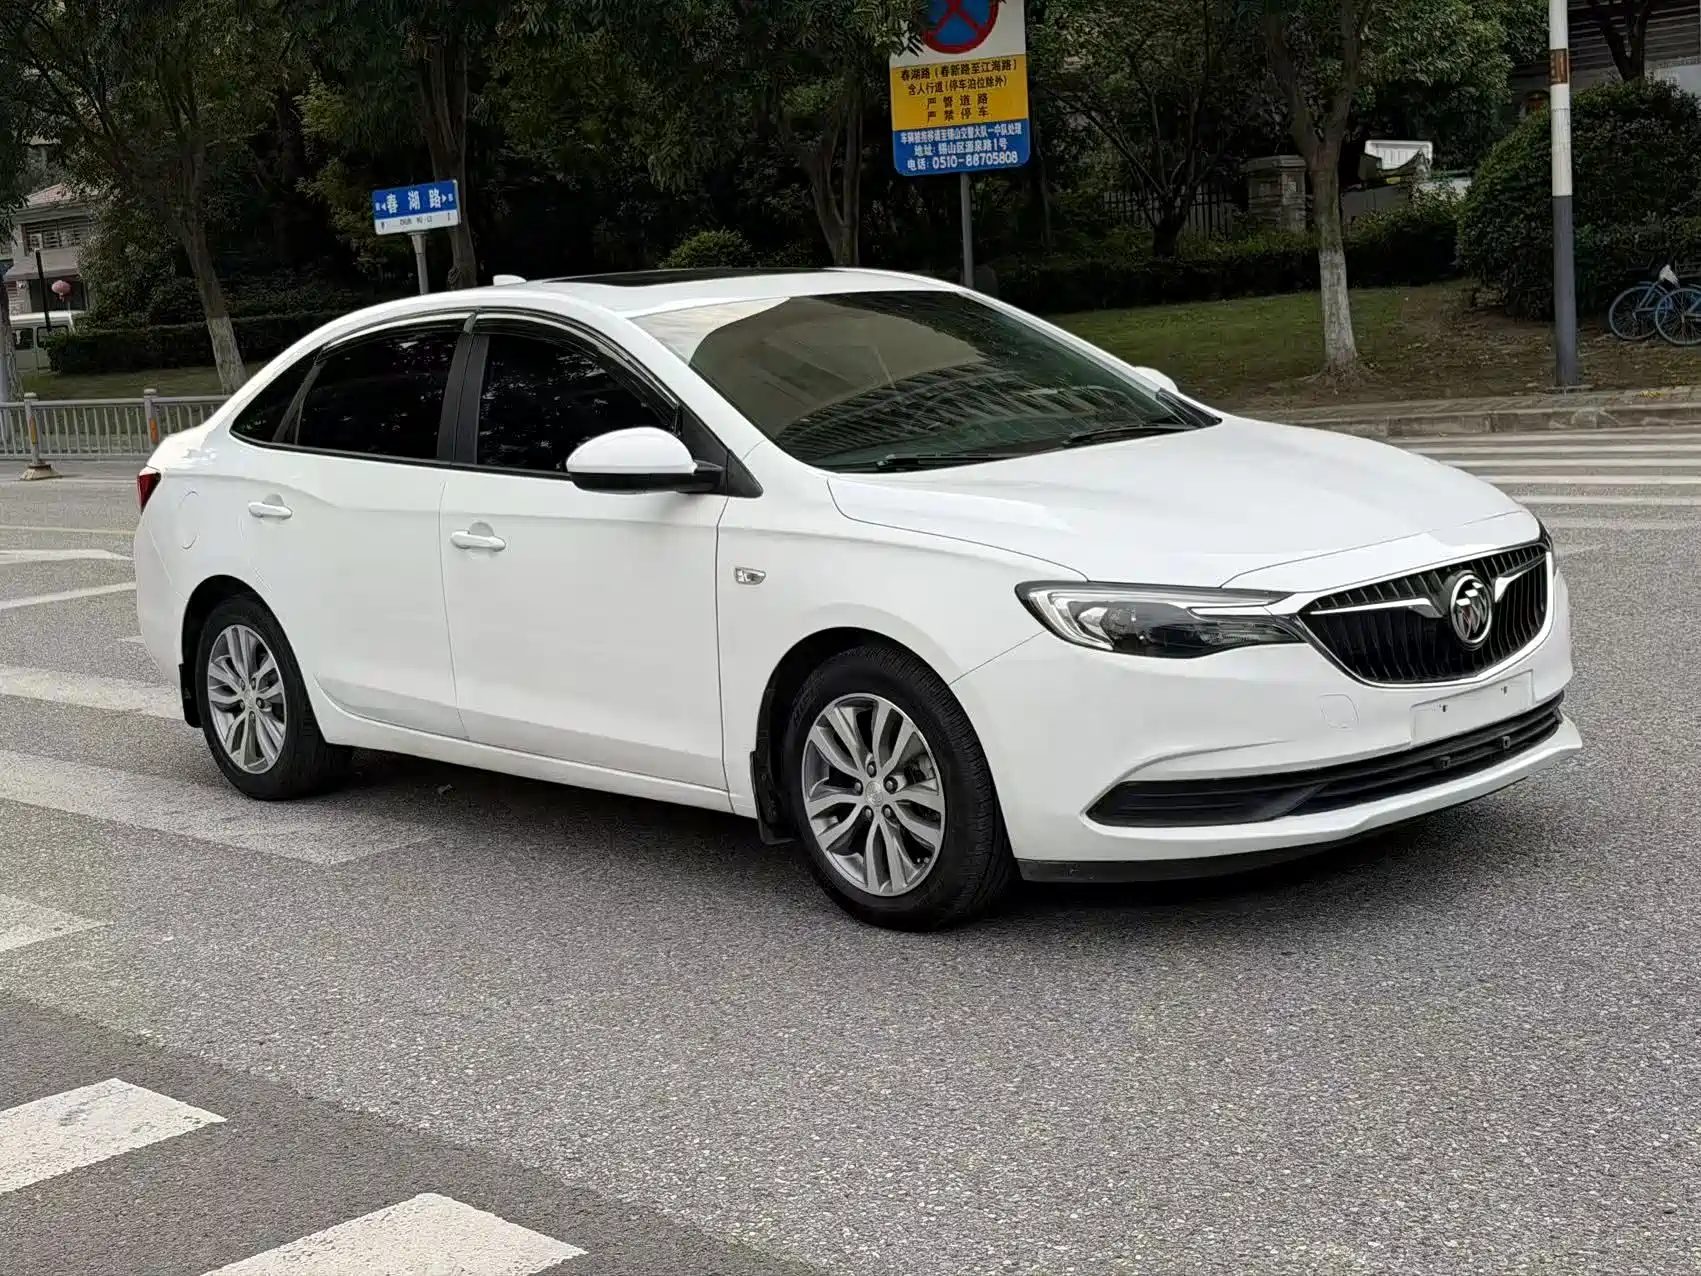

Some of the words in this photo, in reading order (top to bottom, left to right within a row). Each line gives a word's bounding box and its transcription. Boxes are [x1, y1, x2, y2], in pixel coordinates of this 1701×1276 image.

[927, 107, 989, 122] 严禁停车
[386, 187, 442, 214] 春湖路
